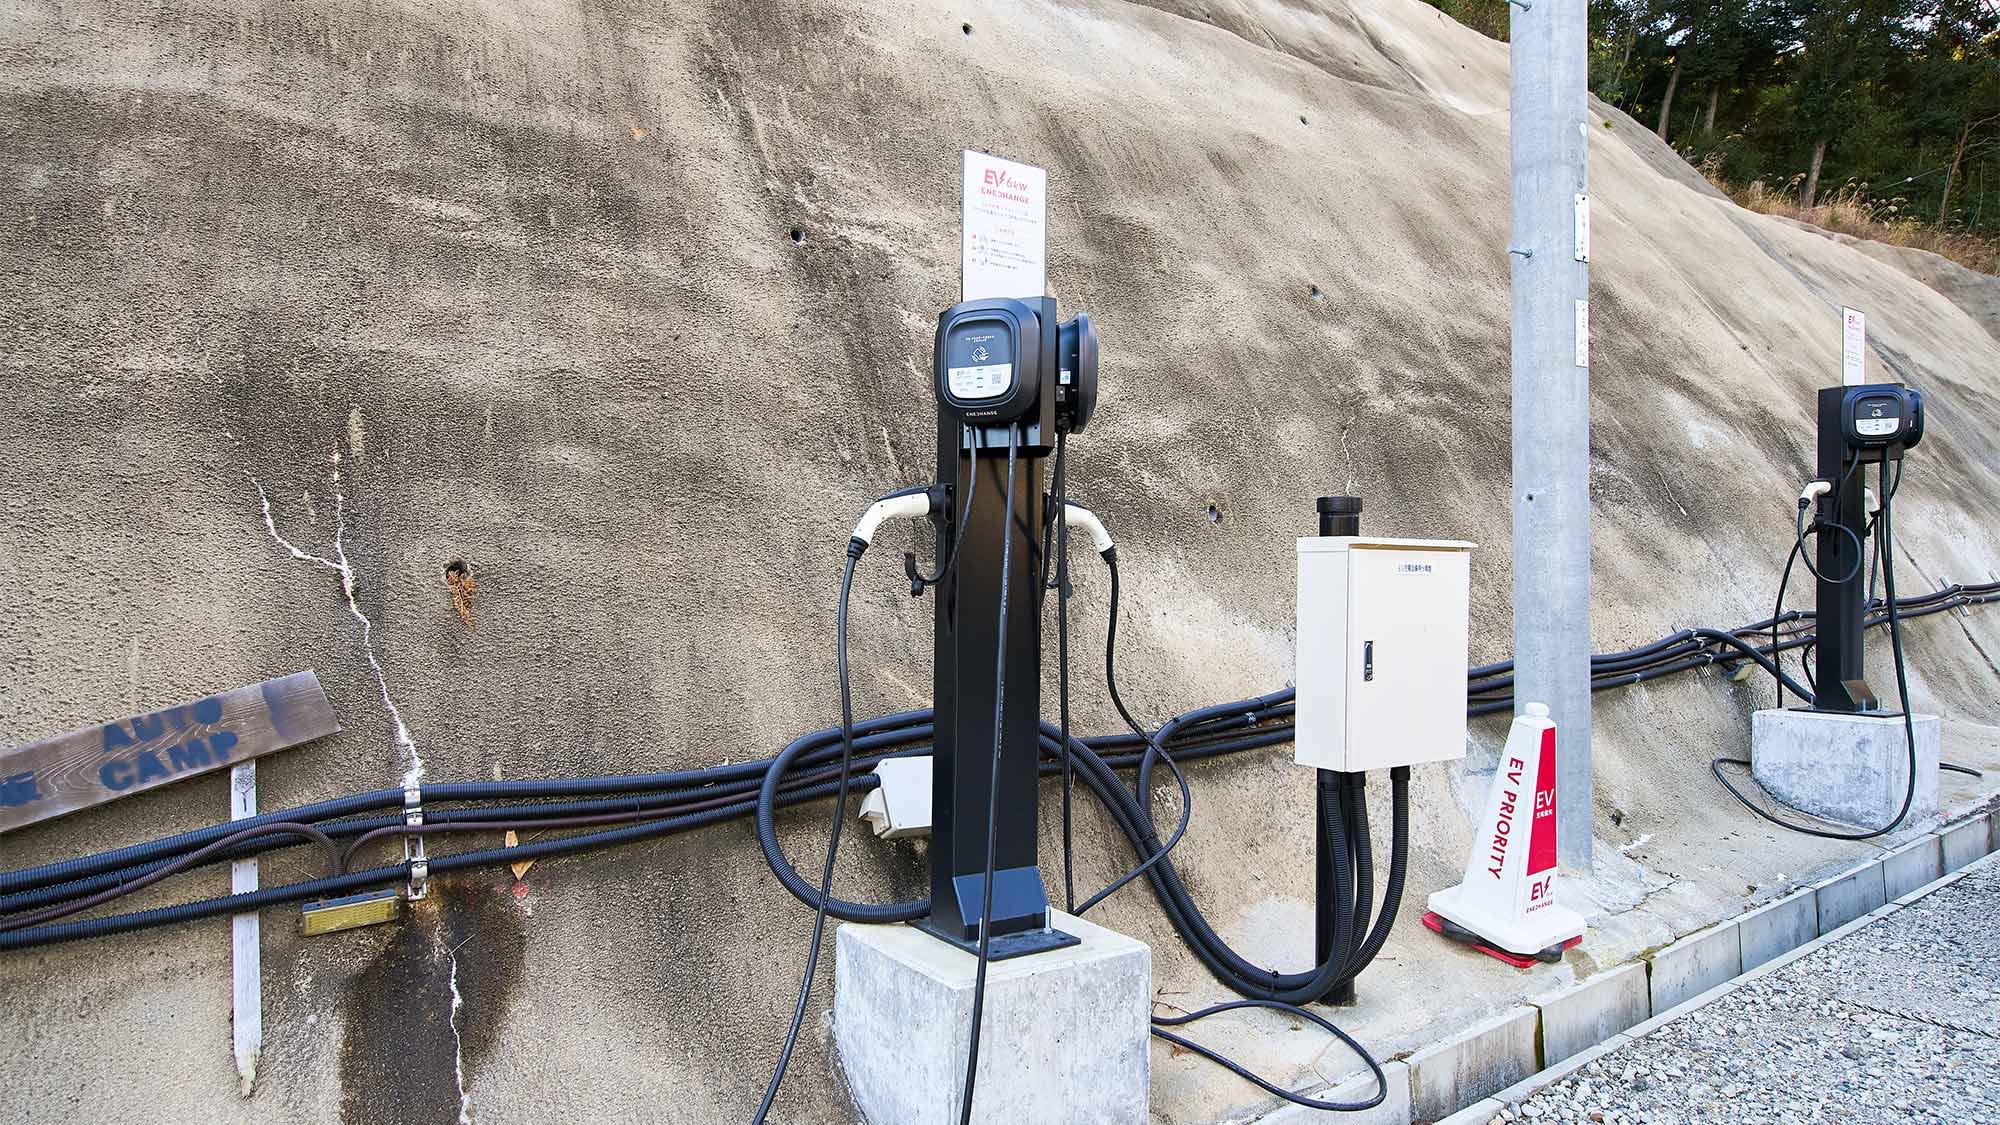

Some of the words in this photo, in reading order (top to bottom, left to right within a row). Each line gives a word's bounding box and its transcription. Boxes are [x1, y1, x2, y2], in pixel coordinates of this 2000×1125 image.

[103, 697, 223, 753] AUTO
[99, 731, 238, 791] CAMP
[1507, 757, 1524, 786] EV
[1536, 788, 1555, 810] EV
[1488, 790, 1517, 880] PRIORITY
[1531, 875, 1551, 901] EV
